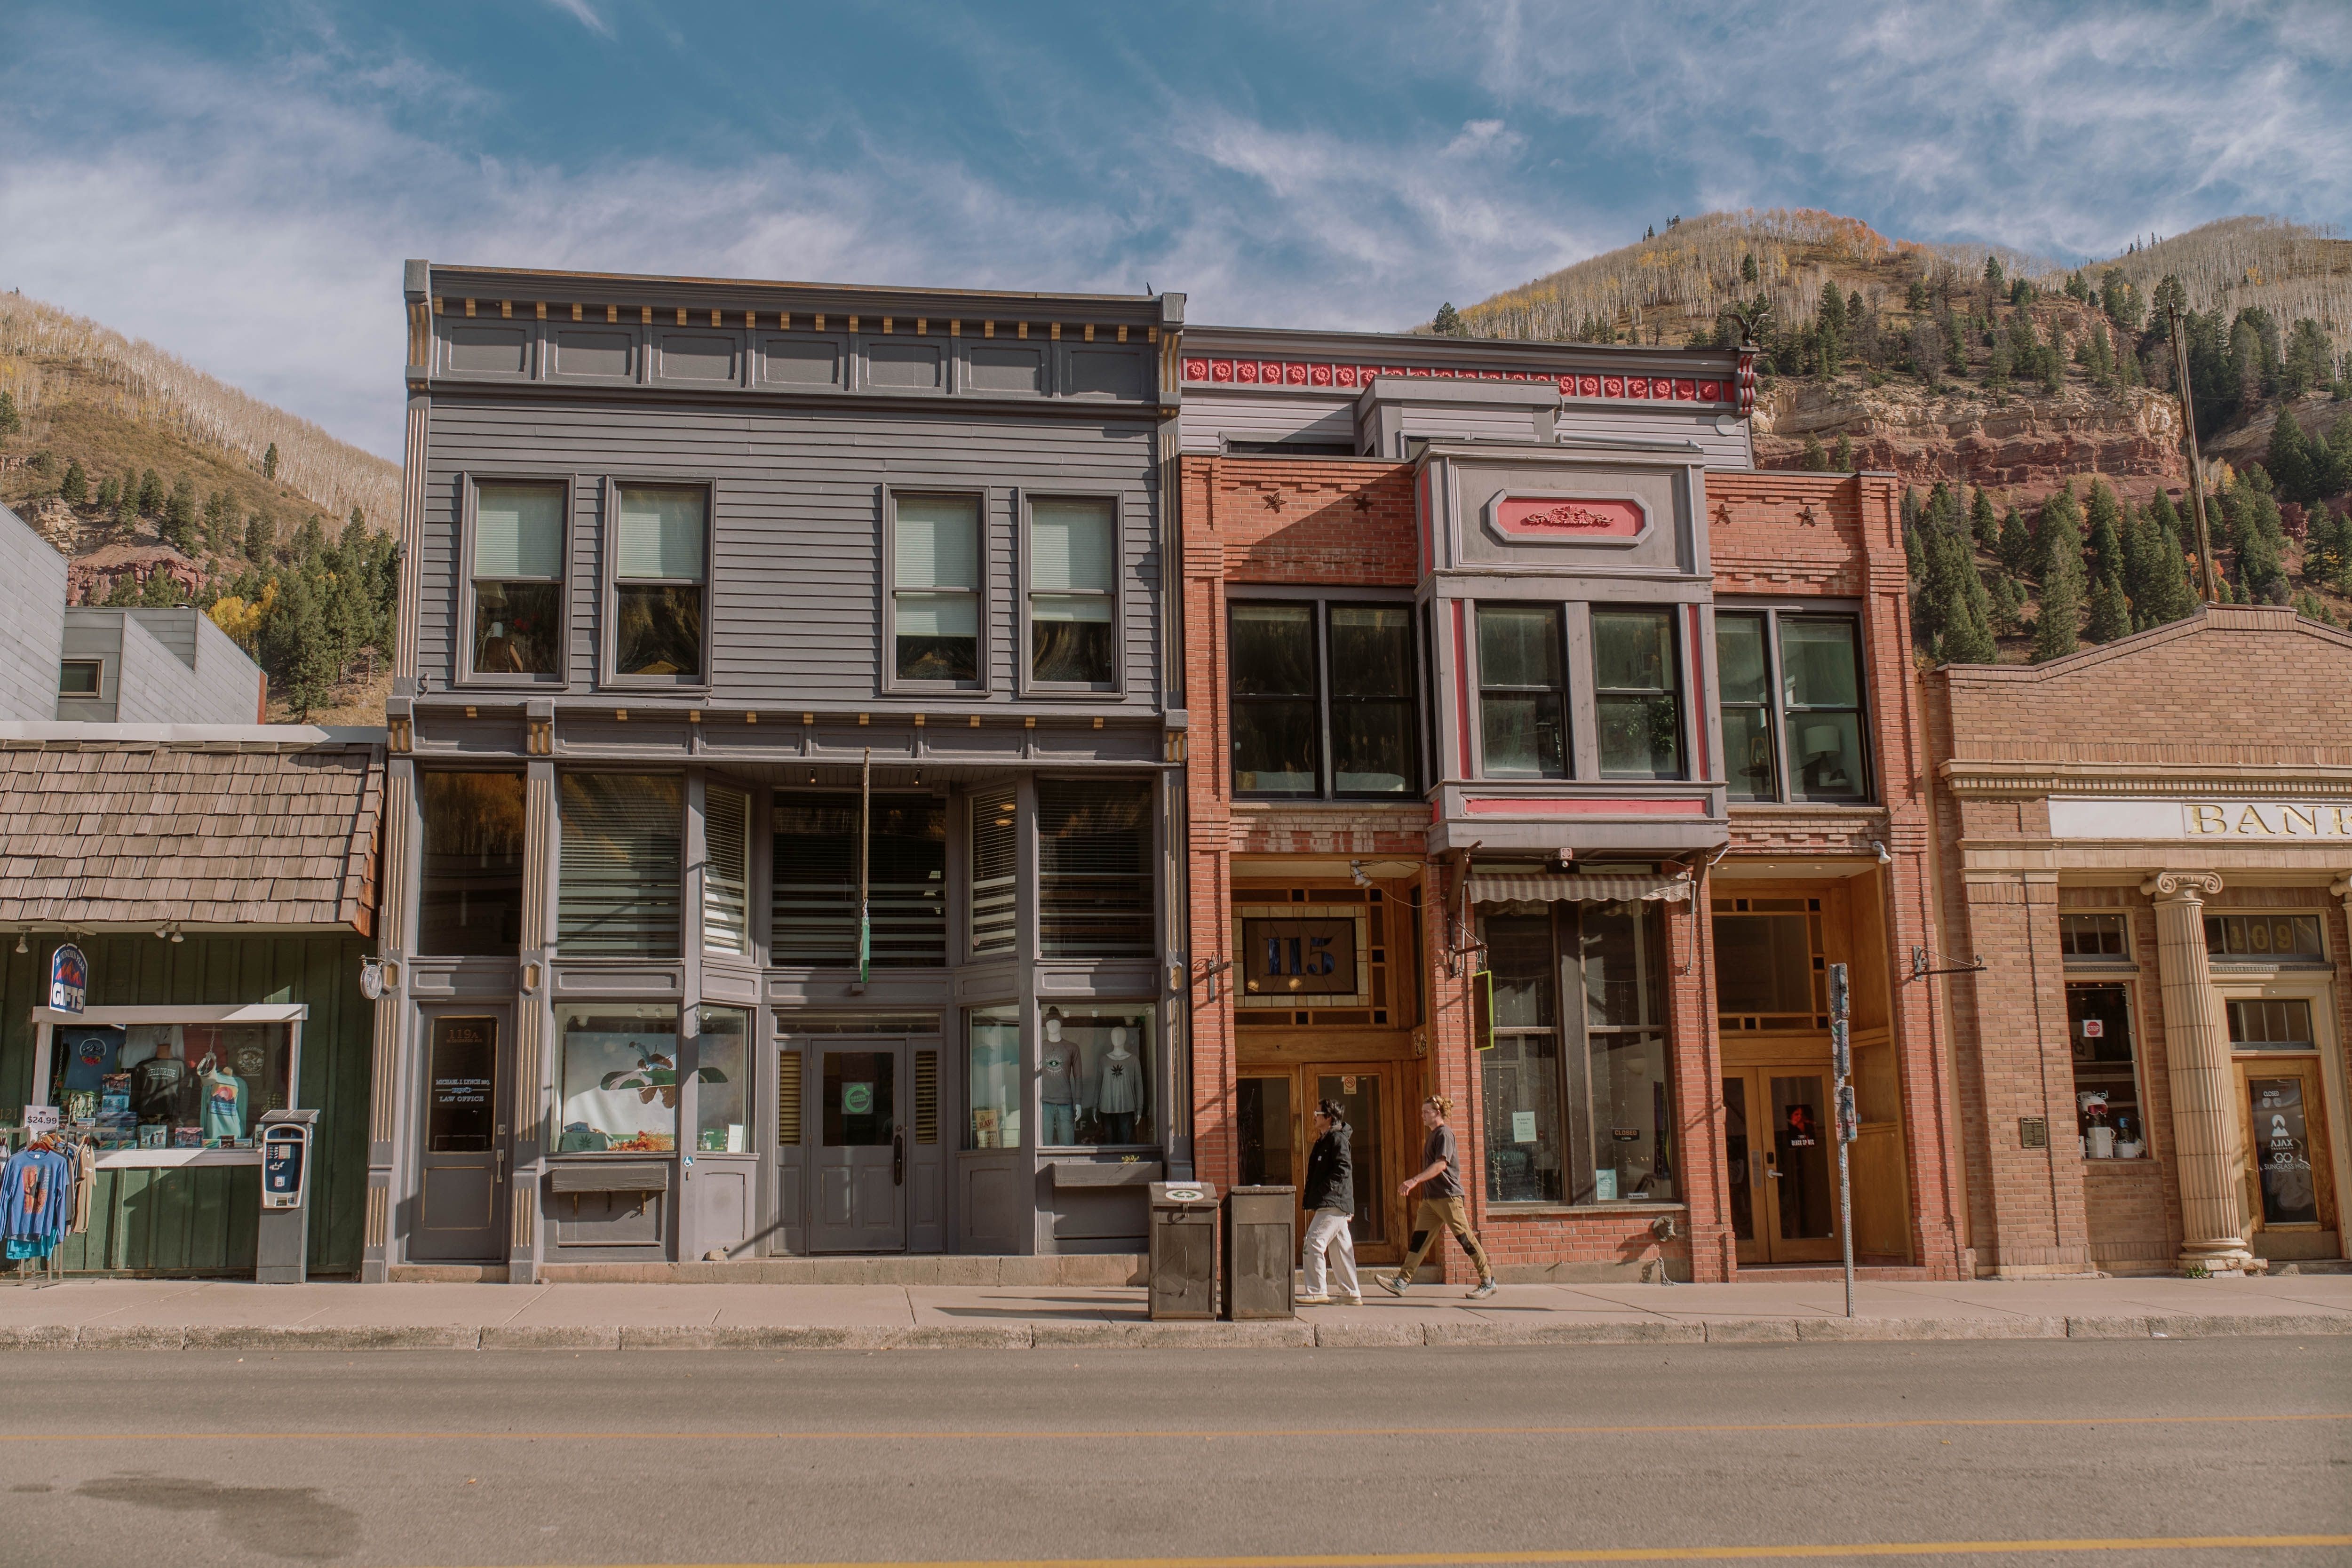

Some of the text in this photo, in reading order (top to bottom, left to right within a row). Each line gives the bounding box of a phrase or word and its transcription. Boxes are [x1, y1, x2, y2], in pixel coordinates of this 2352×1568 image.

[2231, 924, 2292, 950] 109
[56, 949, 86, 974] MOUNTAIN PEAK
[1263, 937, 1335, 977] 115
[52, 982, 84, 1011] GIFTS
[27, 1115, 57, 1124] $24.99
[978, 1118, 994, 1129] RAW
